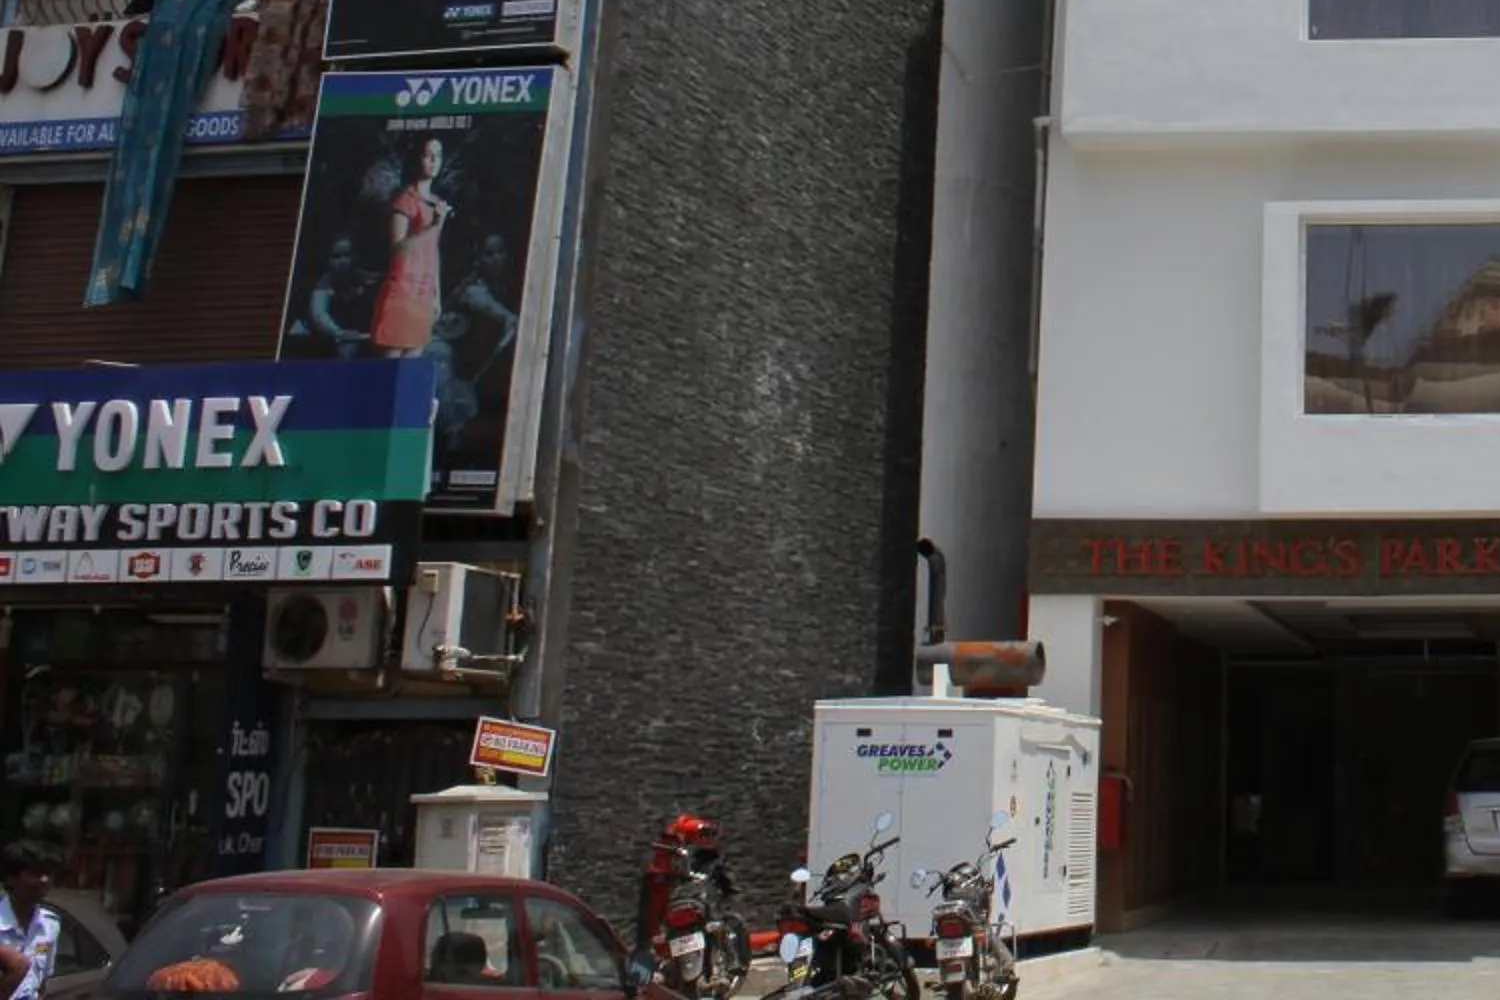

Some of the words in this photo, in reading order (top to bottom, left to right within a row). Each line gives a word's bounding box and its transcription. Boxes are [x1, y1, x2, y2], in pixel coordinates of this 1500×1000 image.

[451, 74, 535, 105] YONEX
[66, 124, 94, 144] FOR
[52, 395, 294, 472] YONEX
[116, 500, 299, 542] SPORTS
[312, 499, 377, 538] CO
[1084, 536, 1186, 575] THE
[1203, 534, 1364, 575] KING'S
[857, 744, 926, 757] GREAVES
[878, 758, 938, 771] POWER
